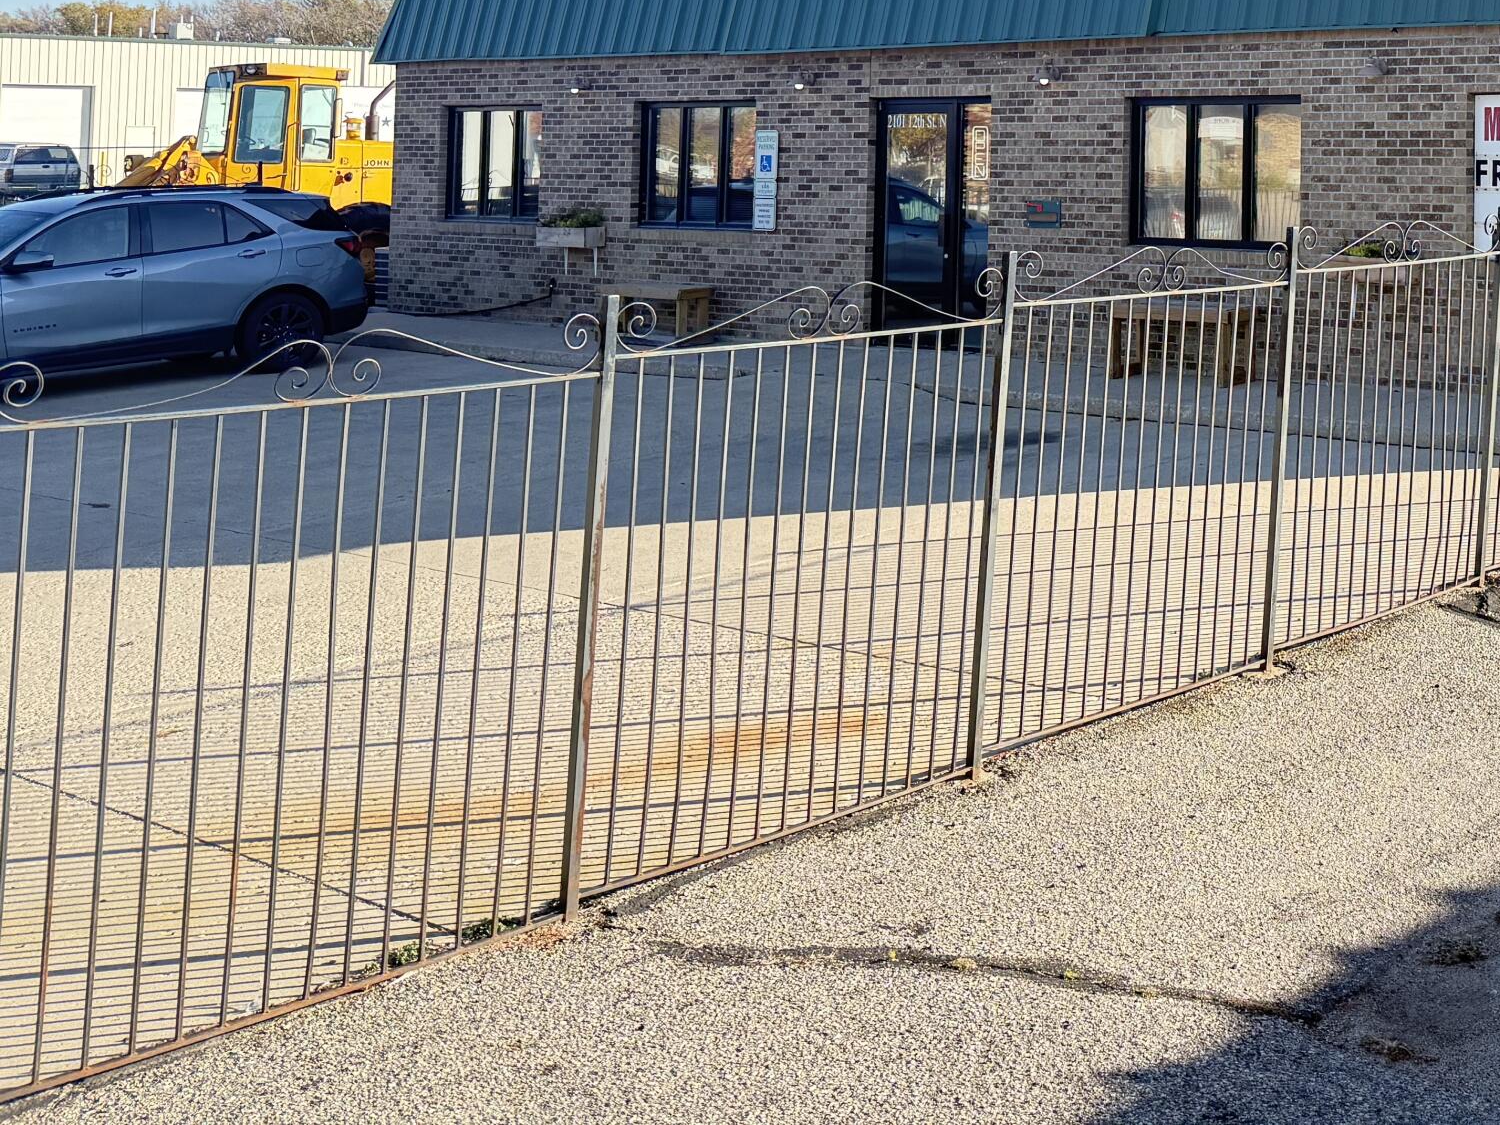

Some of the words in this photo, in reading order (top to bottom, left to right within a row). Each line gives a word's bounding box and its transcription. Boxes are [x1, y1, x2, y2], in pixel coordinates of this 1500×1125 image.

[887, 114, 905, 128] 2101
[908, 114, 925, 128] 12th
[939, 114, 947, 128] N
[974, 129, 986, 178] OPEN
[364, 159, 390, 167] JOHN
